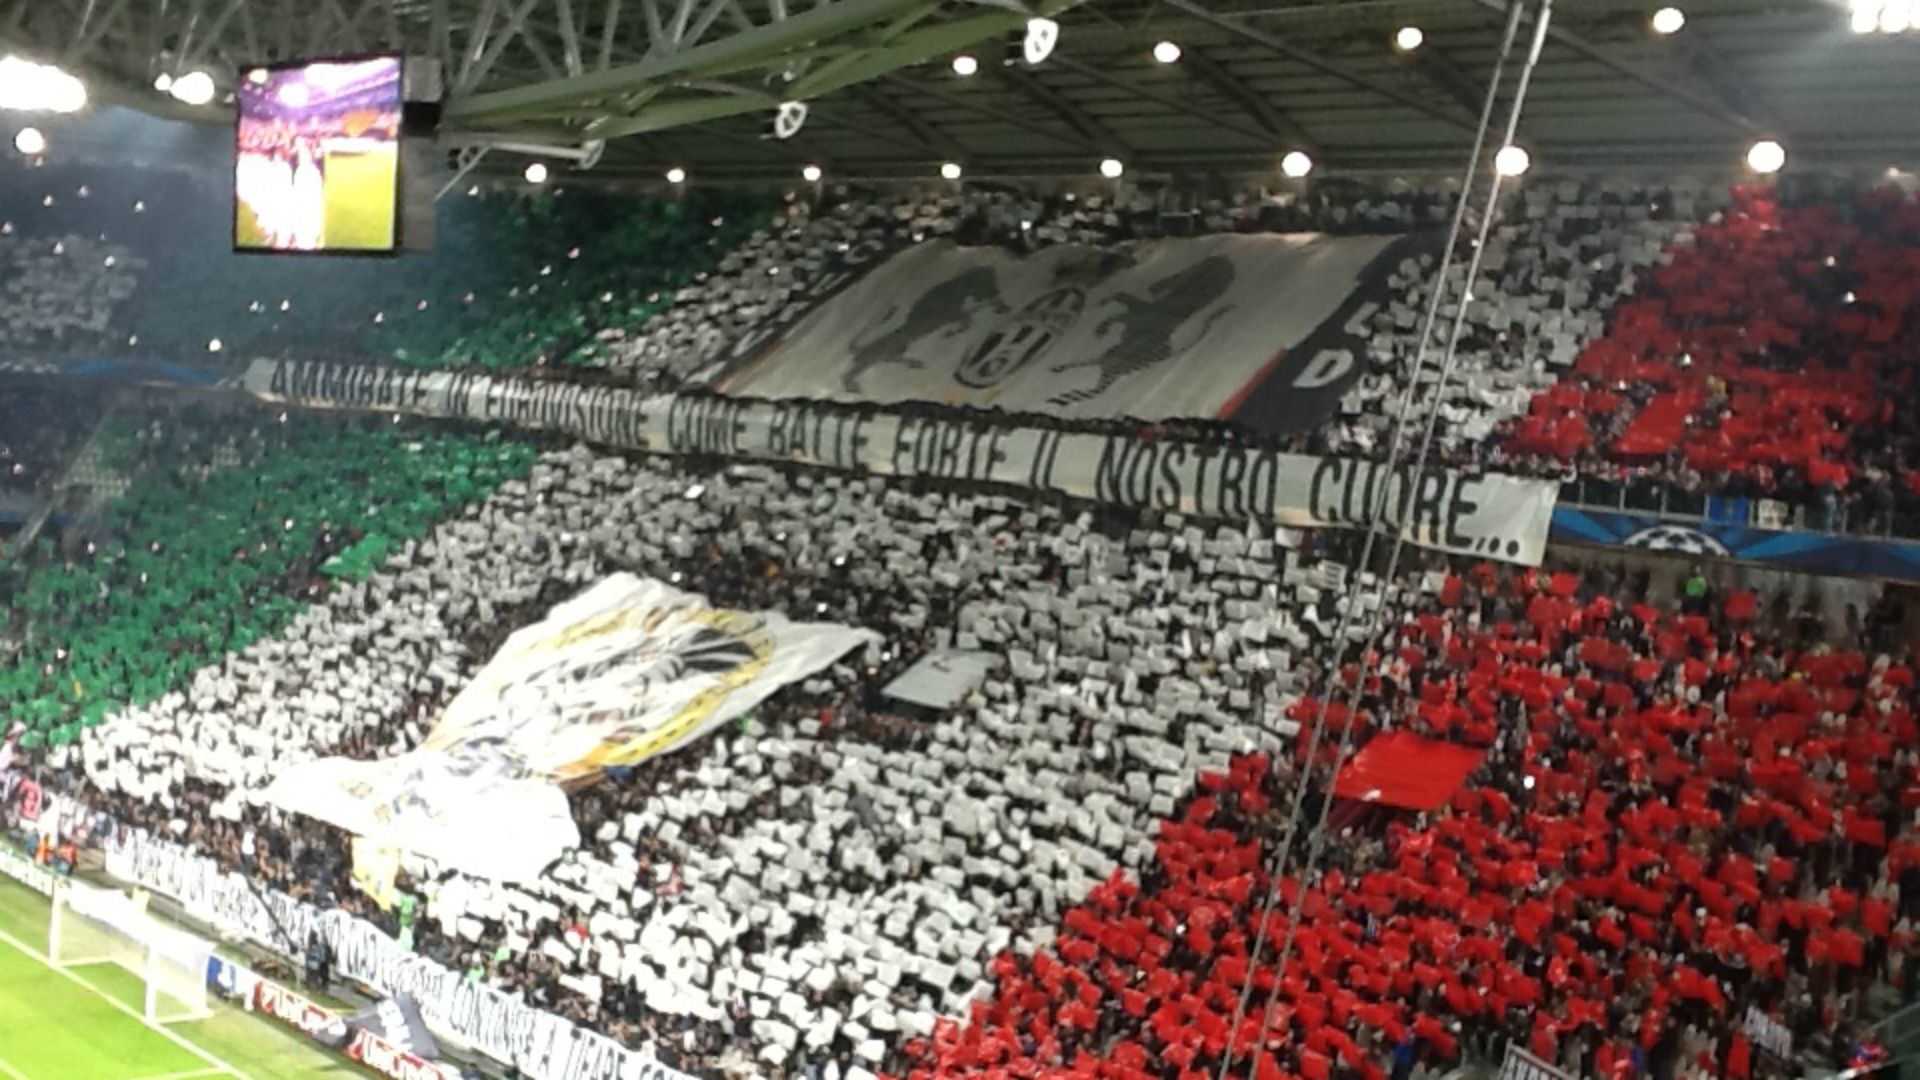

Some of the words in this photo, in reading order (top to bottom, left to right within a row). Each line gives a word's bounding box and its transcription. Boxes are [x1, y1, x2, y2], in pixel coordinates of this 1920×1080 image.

[667, 391, 750, 456] COME
[766, 402, 868, 471] BATTE
[894, 414, 1006, 484] FORTE
[1097, 433, 1279, 518] NOSTRO
